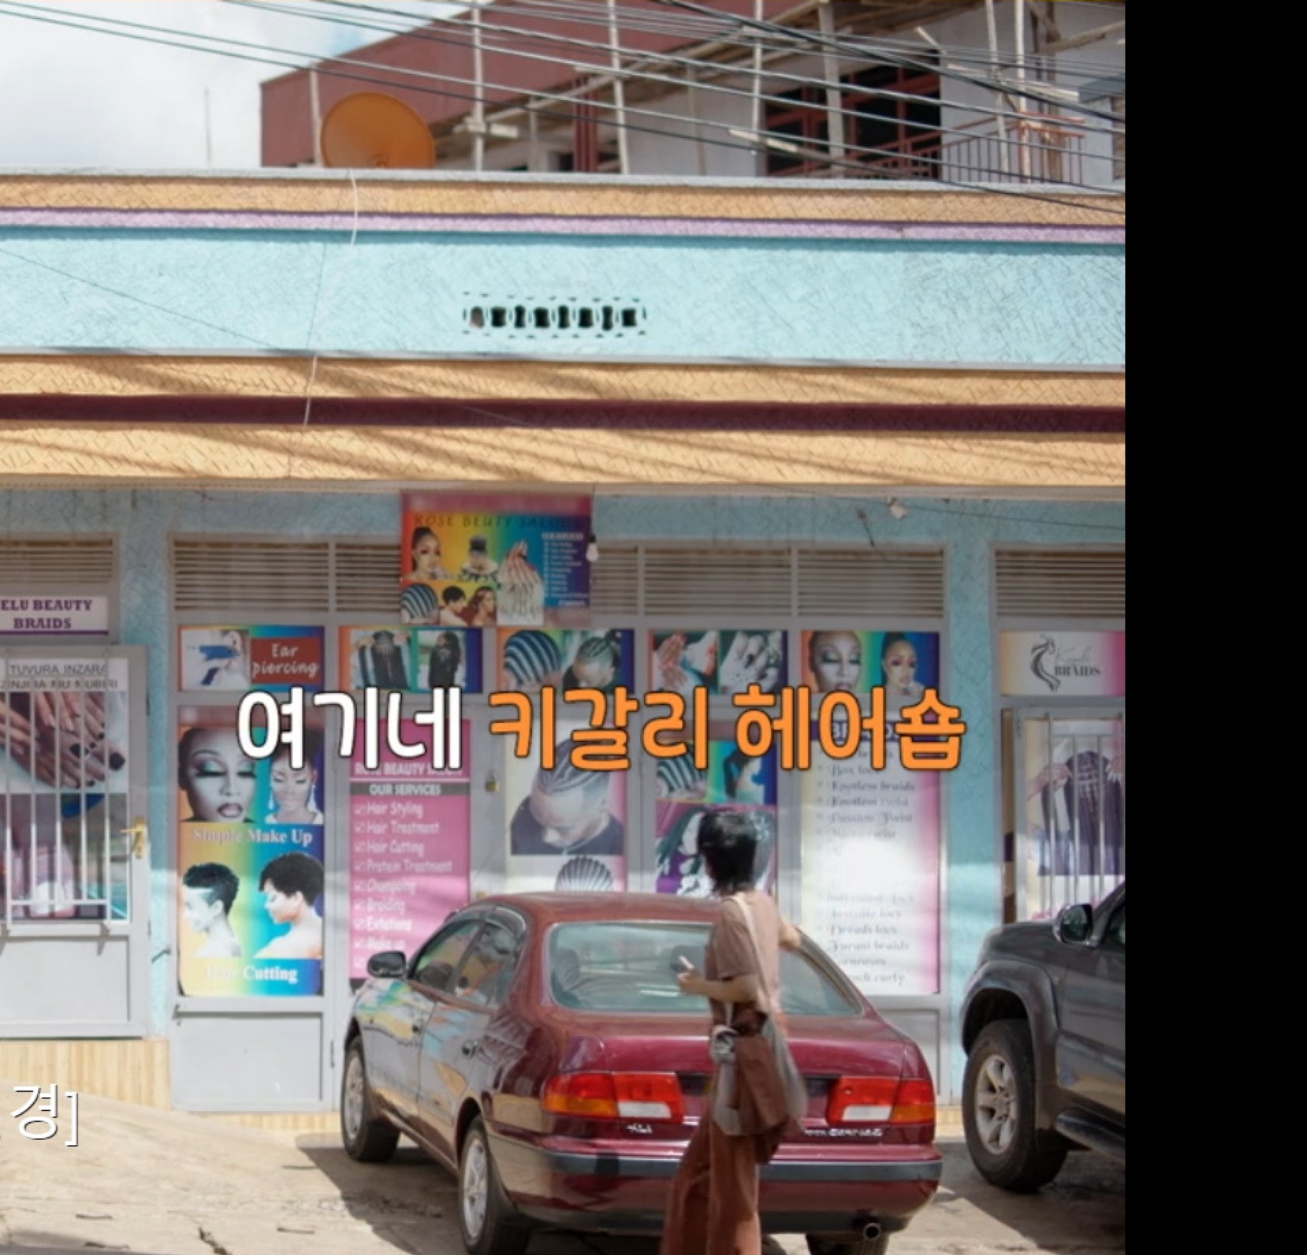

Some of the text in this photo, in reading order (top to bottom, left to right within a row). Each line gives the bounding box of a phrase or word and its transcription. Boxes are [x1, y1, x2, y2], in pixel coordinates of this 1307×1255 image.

[33, 599, 93, 611] BEAUTY
[13, 617, 72, 629] BRAIDS
[271, 643, 298, 658] Ear
[252, 660, 319, 679] piercing
[1054, 665, 1101, 677] BRAIDS
[384, 762, 426, 775] BEAUTY
[369, 783, 442, 796] OUR SERVICES
[367, 800, 424, 820] Hair Styling
[367, 819, 440, 834] Hair Treatment
[246, 828, 288, 843] Make
[290, 828, 314, 847] Up
[367, 839, 425, 858] Hair Cutting
[403, 858, 453, 873] Treatment
[242, 965, 298, 985] Cutting
